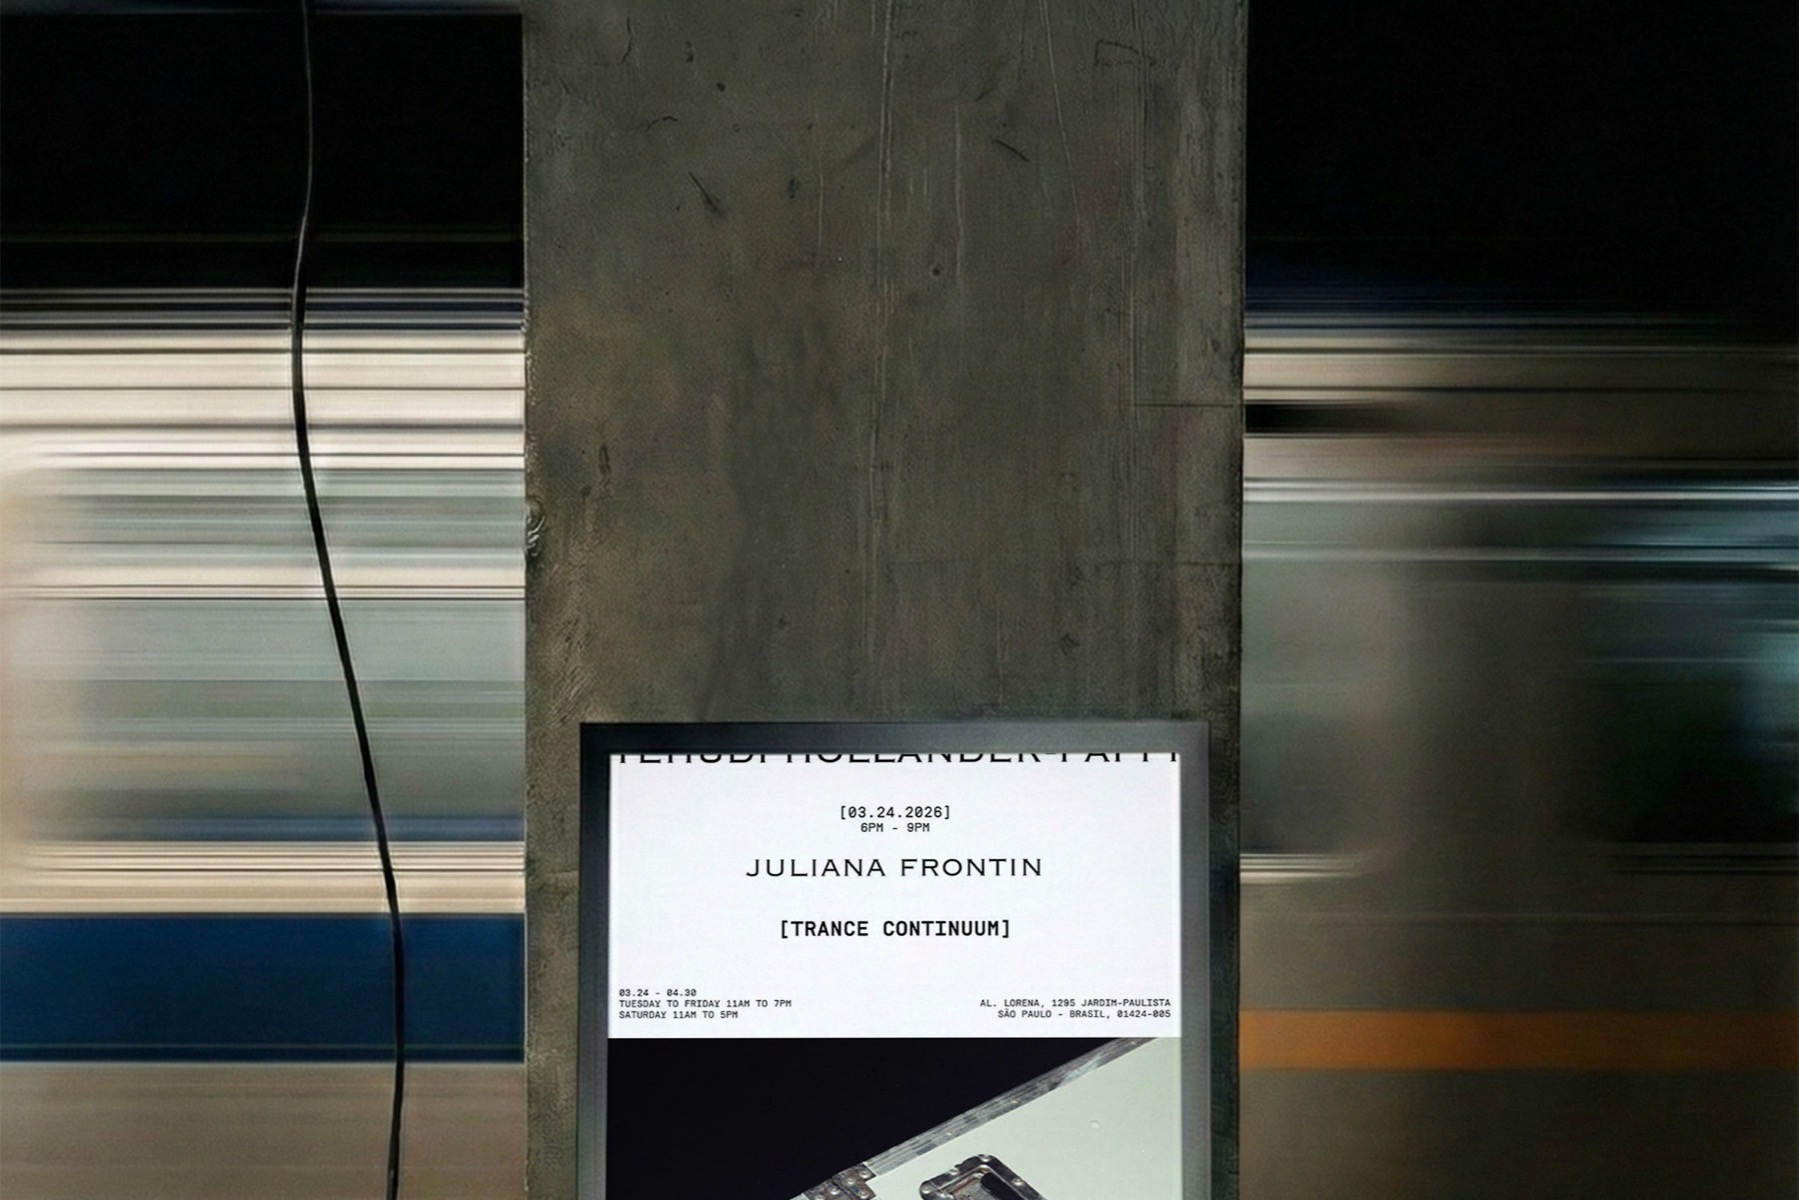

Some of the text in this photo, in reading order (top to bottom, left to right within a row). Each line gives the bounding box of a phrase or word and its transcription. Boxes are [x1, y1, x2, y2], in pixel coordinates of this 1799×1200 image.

[841, 805, 949, 820] [03.24.2026]
[861, 823, 883, 832] 6PM
[907, 823, 930, 832] 9PM
[746, 859, 1041, 877] JULIANA FRONTIN
[781, 920, 1009, 939] [TRANCE CONTINUUM]
[618, 989, 649, 997] 03.24
[666, 989, 696, 997] 04.30
[619, 1000, 791, 1008] TUESDAY TO FRIDAY 11AM TO 7PM
[980, 999, 1171, 1008] AL. LORENA, 1295 JARDIM-PAULISTA
[619, 1011, 738, 1019] SATURDAY 11AM TO 5PM
[998, 1008, 1016, 1018] SÃO
[1022, 1010, 1051, 1018] PAULO
[1070, 1010, 1109, 1019] BRASIL,
[1116, 1010, 1171, 1018] 01424-005
